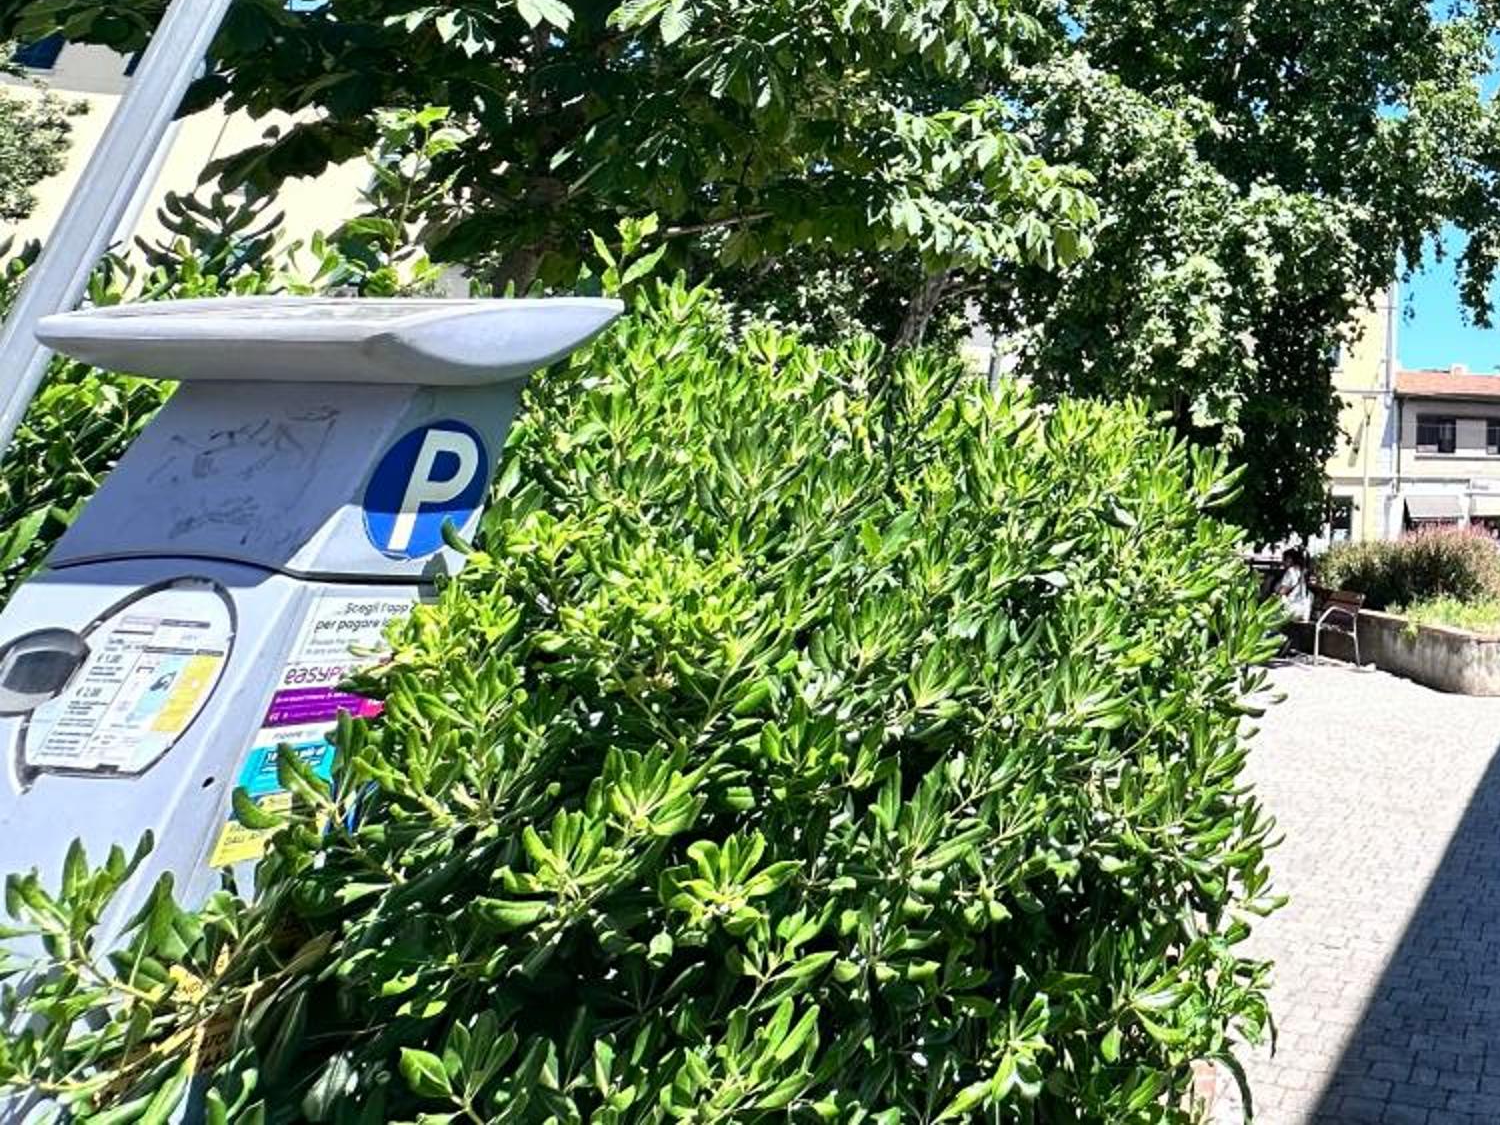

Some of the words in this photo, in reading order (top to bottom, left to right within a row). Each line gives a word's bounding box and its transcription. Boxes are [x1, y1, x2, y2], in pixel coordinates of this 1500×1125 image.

[388, 429, 479, 550] P
[314, 620, 336, 633] per
[336, 620, 380, 633] pagare
[284, 666, 345, 684] easyP
